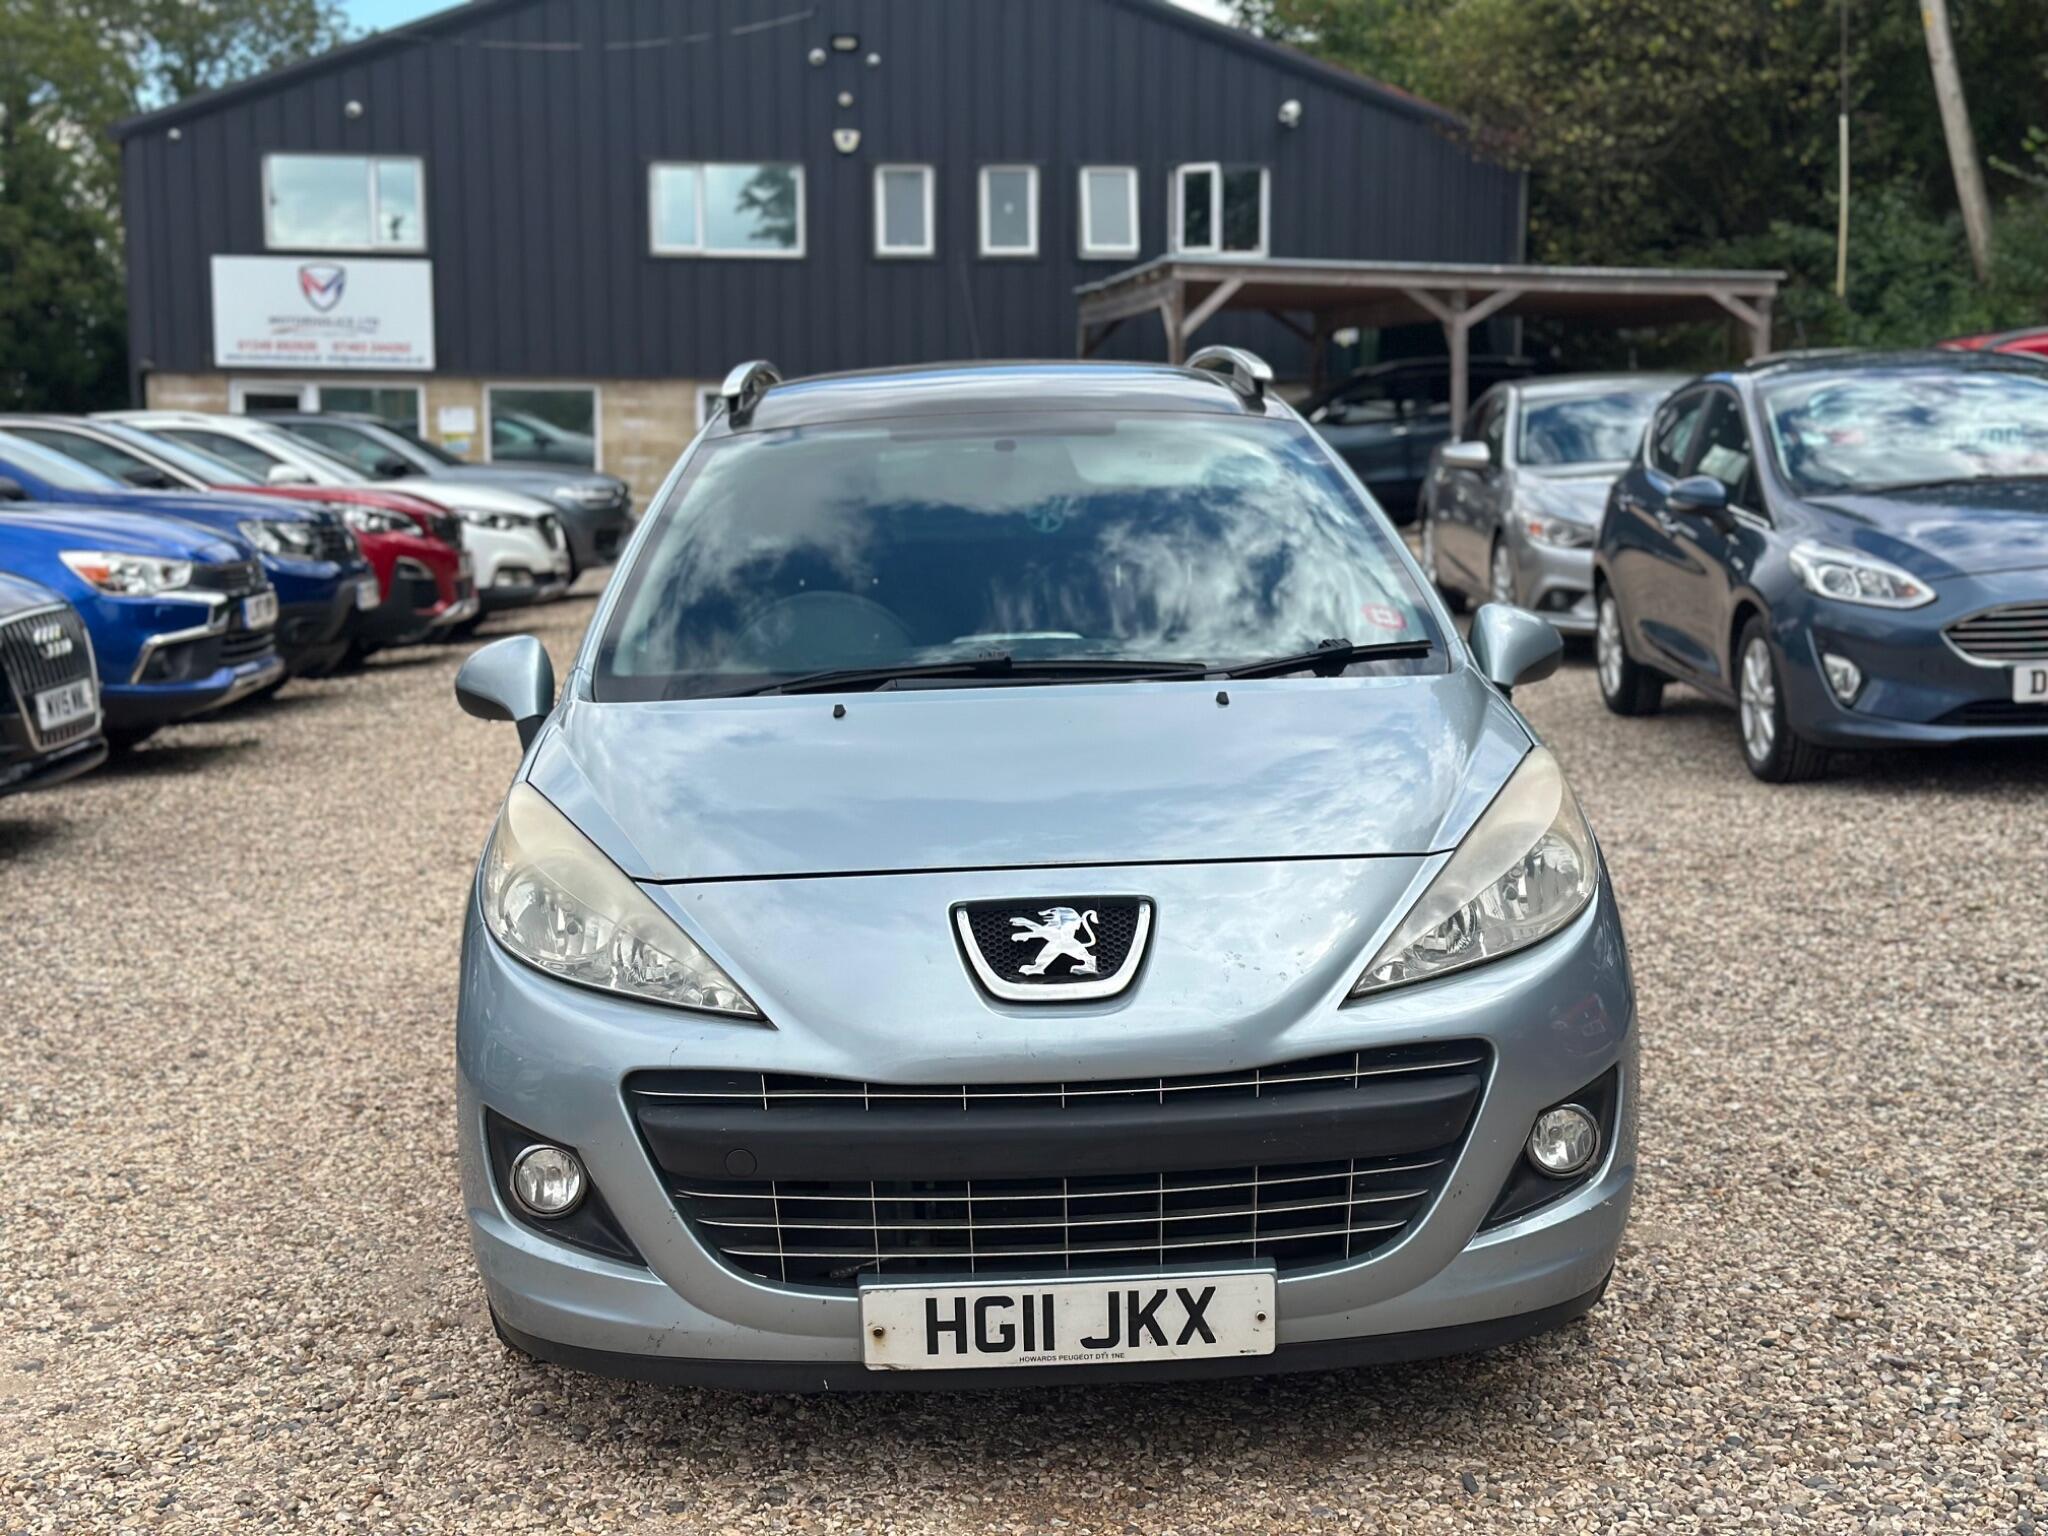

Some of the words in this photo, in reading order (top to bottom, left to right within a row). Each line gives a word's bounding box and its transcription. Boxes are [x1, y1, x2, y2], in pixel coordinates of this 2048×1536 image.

[925, 1293, 1055, 1355] HG11
[1079, 1286, 1217, 1349] JKX
[1019, 1355, 1057, 1363] HOWARDS
[1058, 1353, 1094, 1361] PEUGEOT
